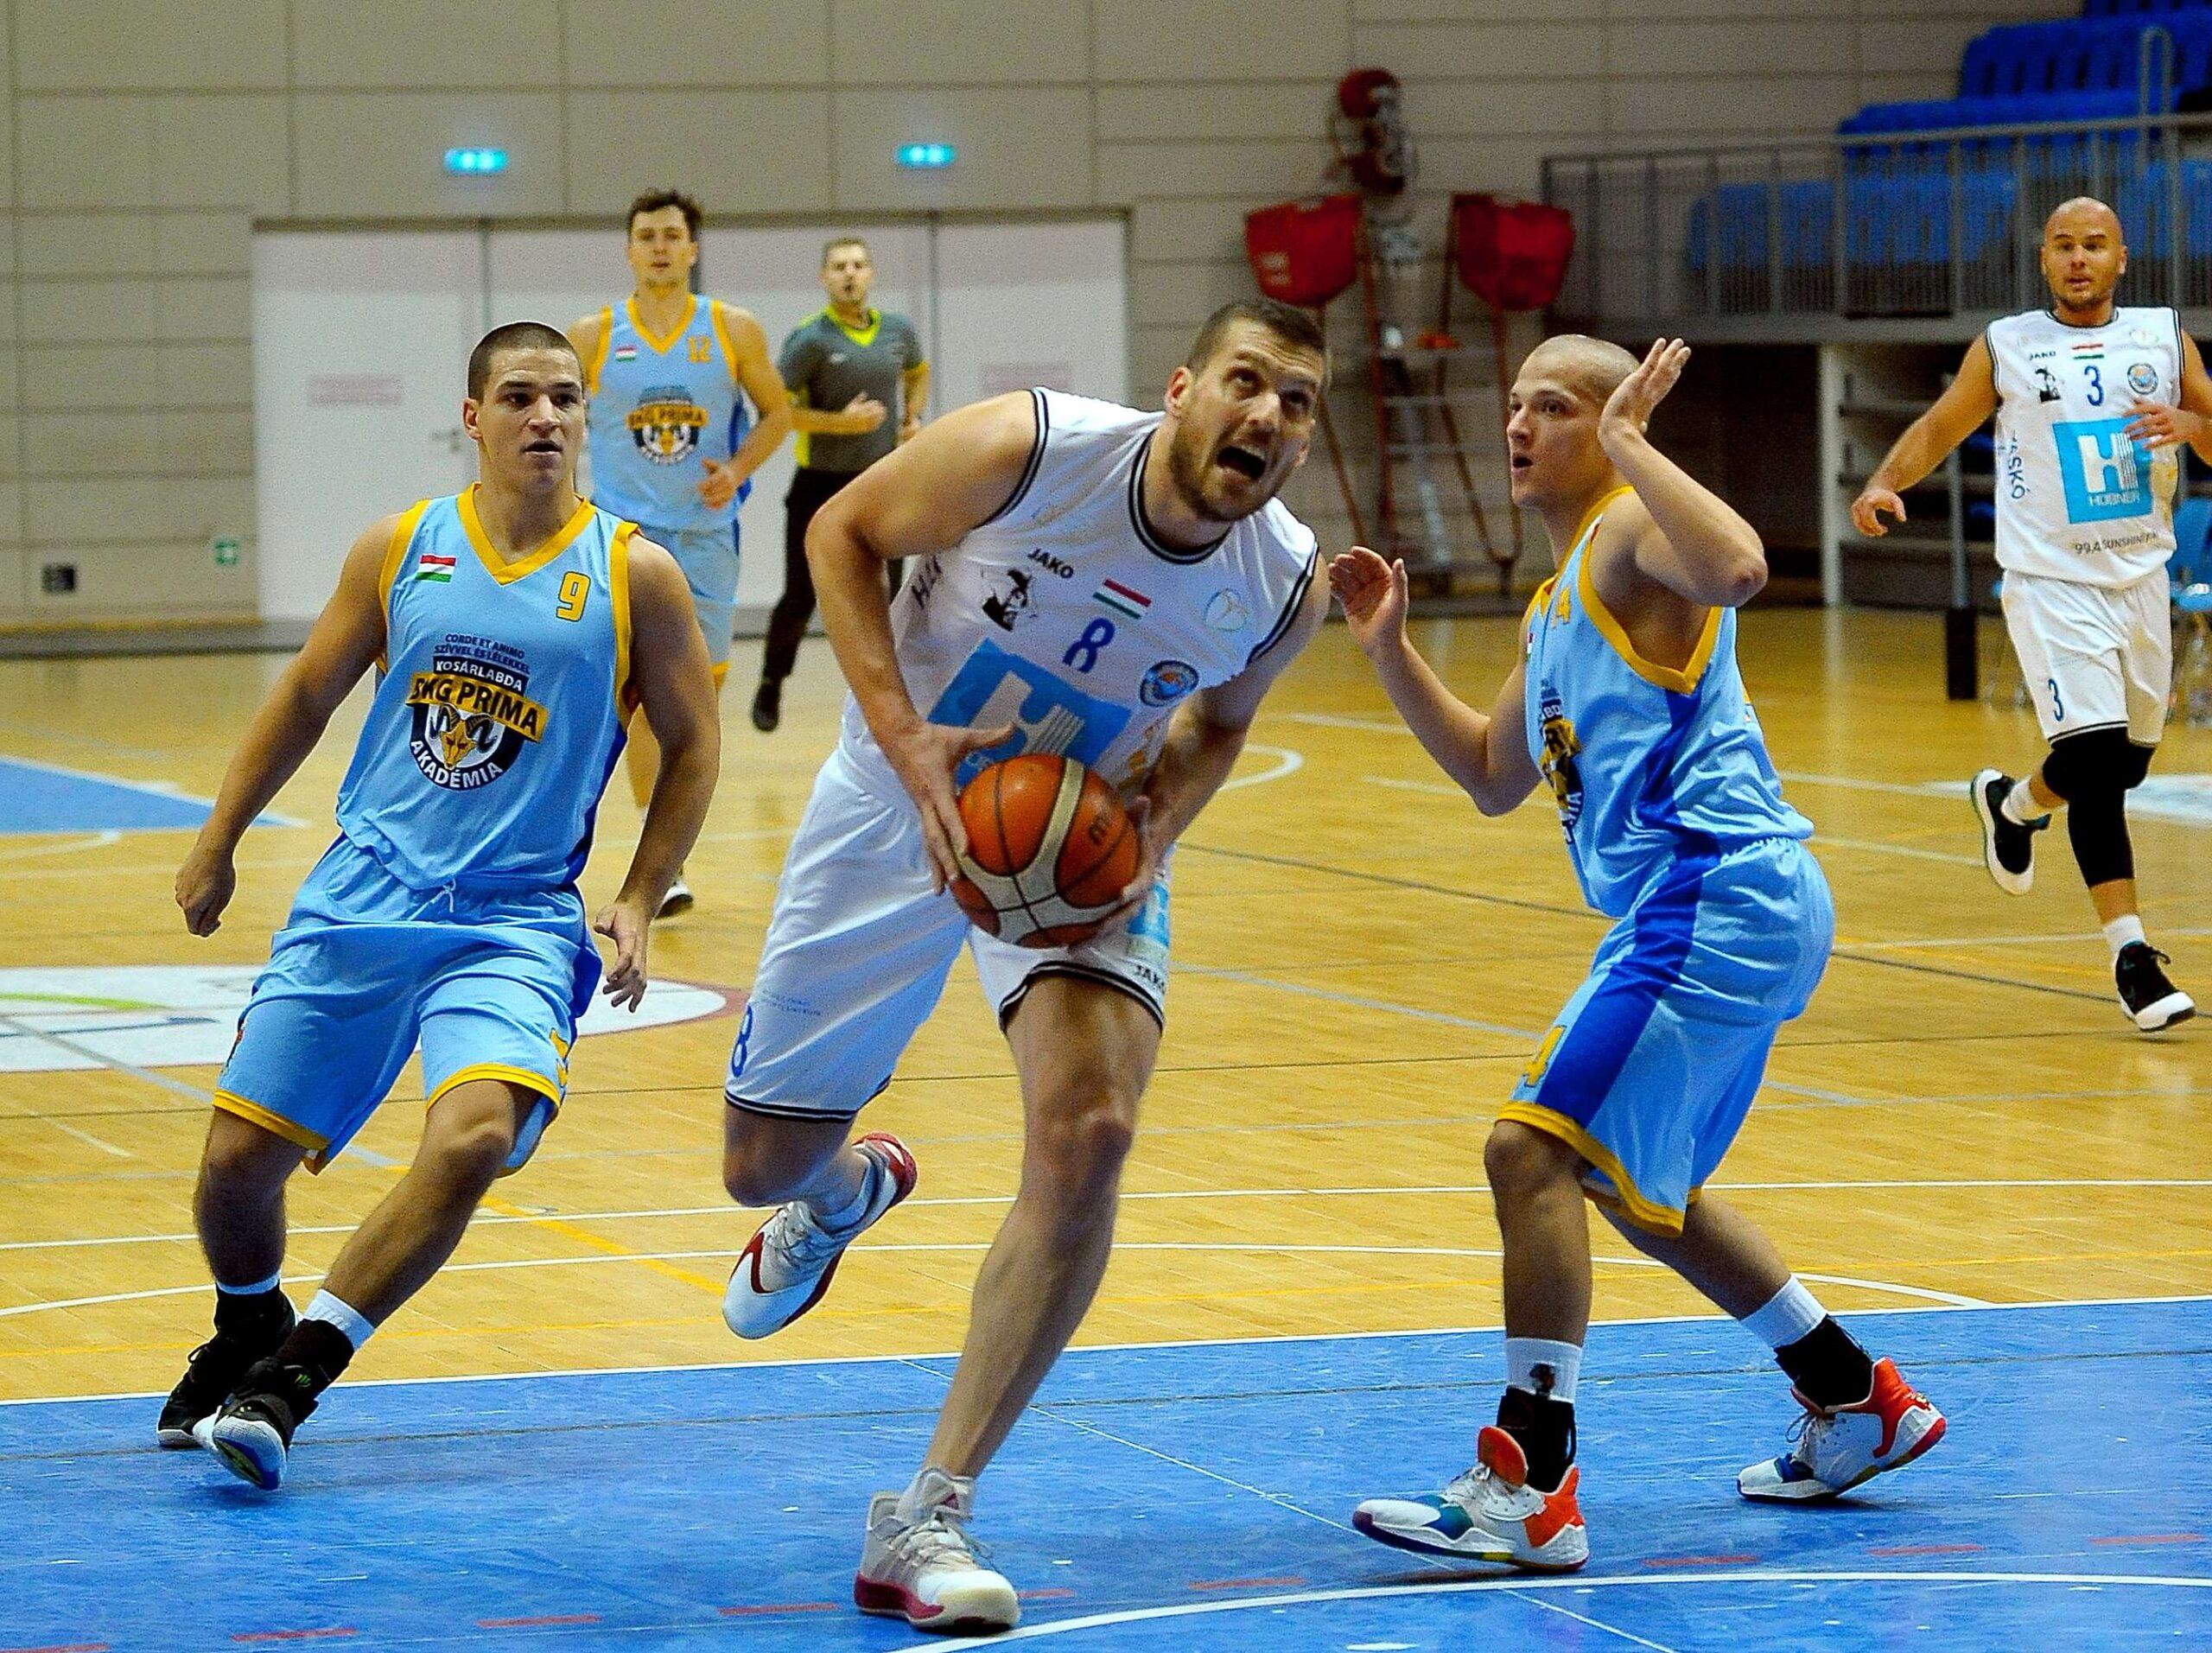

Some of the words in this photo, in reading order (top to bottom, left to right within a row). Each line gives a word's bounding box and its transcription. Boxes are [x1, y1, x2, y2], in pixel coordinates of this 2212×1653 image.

[687, 335, 711, 363] 12
[2083, 365, 2105, 407] 3
[1027, 548, 1075, 579] JAKO
[556, 571, 591, 622] 9
[445, 633, 479, 645] CORDE
[480, 639, 493, 649] ET
[493, 642, 525, 659] ANIMO
[1062, 618, 1116, 673] 8
[435, 658, 523, 691] KOSÁRLABDA
[456, 682, 539, 736] PRIMA
[2048, 678, 2064, 722] 3
[410, 740, 504, 788] AKADÉMIA
[731, 1005, 753, 1078] 8
